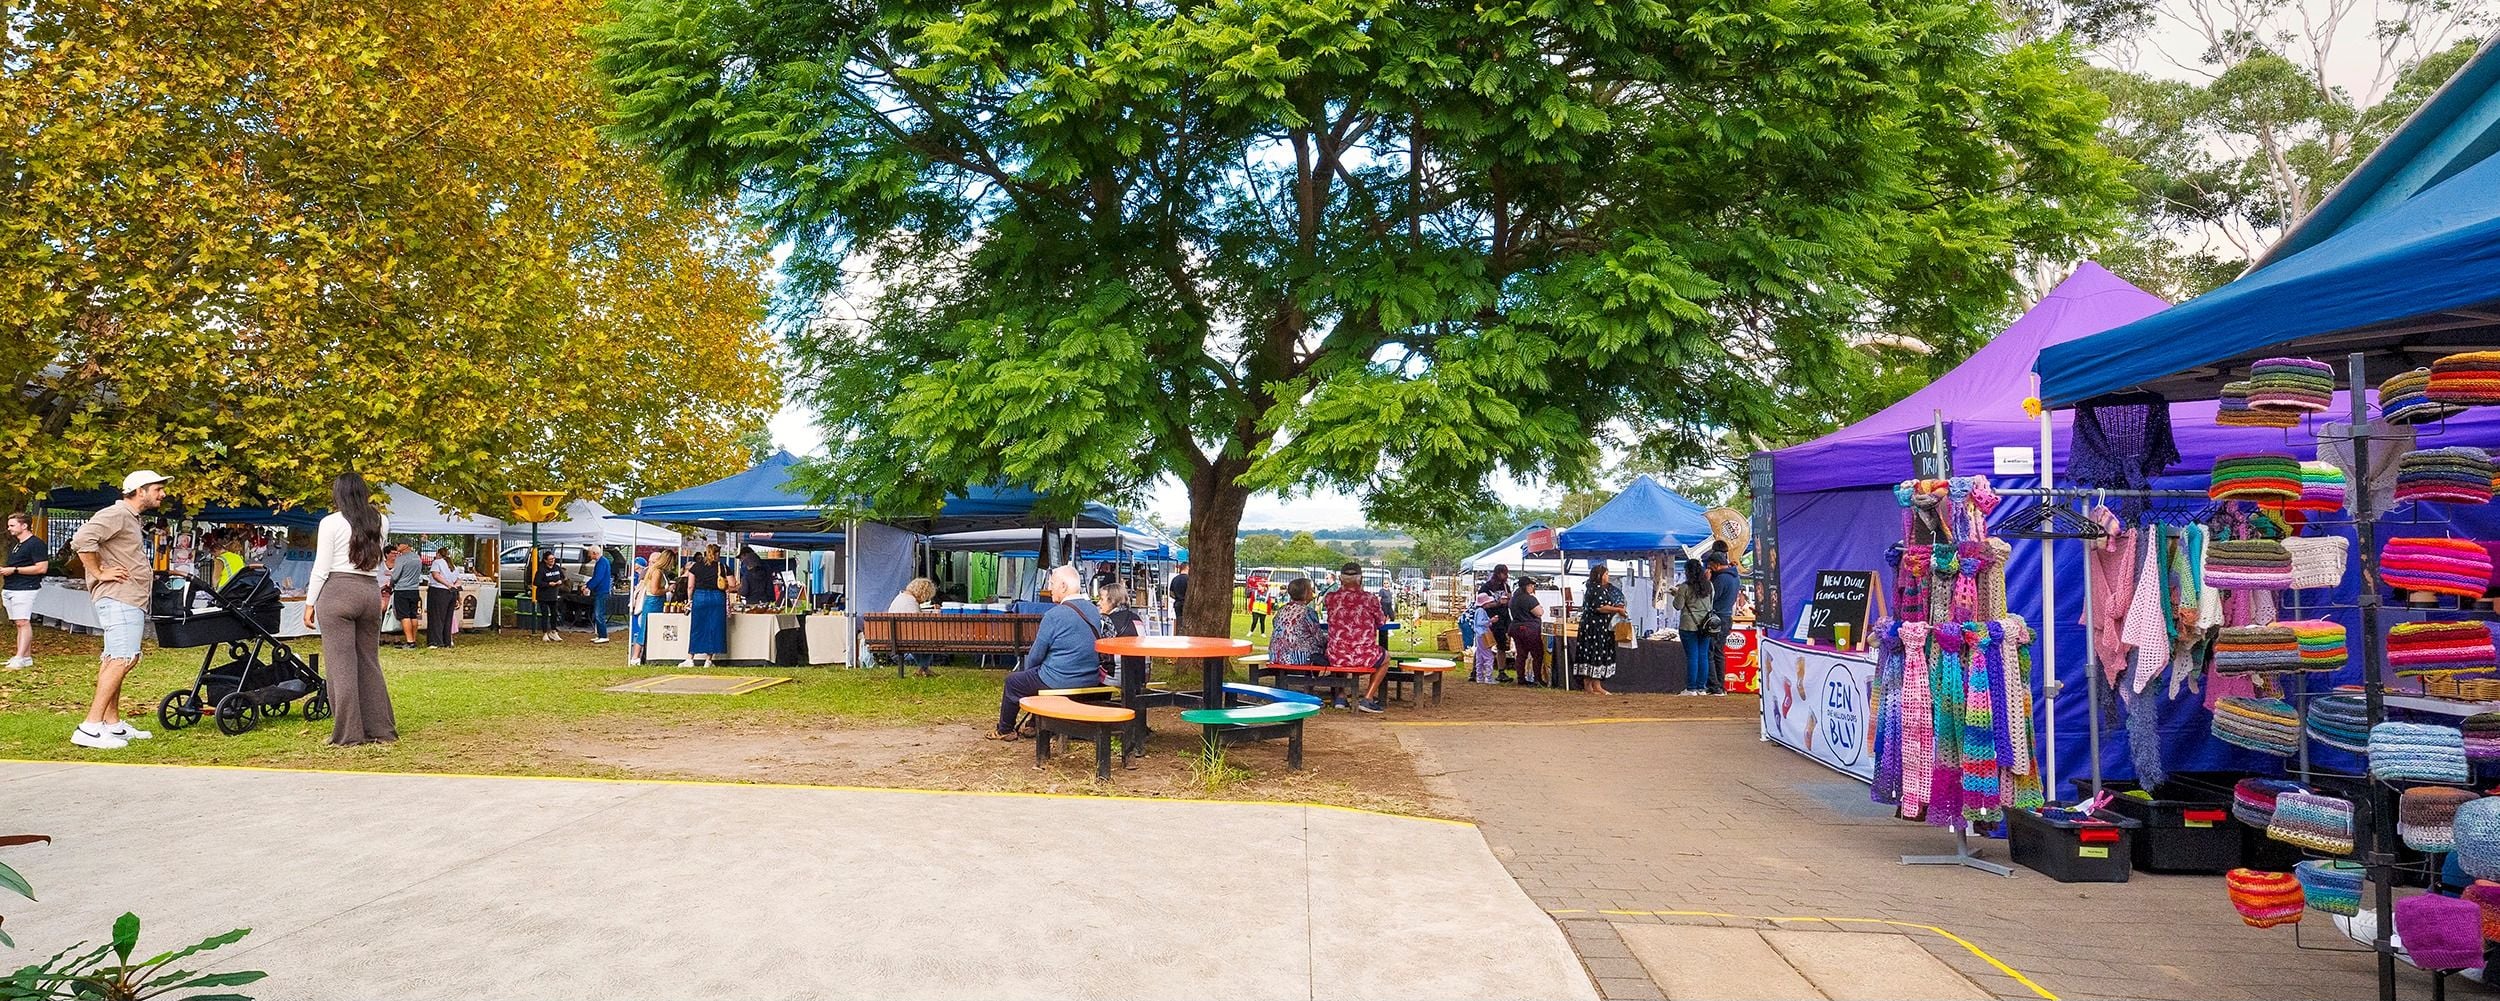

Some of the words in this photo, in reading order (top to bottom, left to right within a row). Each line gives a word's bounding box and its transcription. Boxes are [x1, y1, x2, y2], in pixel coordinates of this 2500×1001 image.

[1909, 432, 1931, 456] COLD
[1922, 454, 1950, 476] DRIS
[1822, 574, 1842, 587] NEW
[1843, 575, 1865, 589] DUAL
[1811, 608, 1831, 628] $12
[1828, 681, 1853, 713] ZEN
